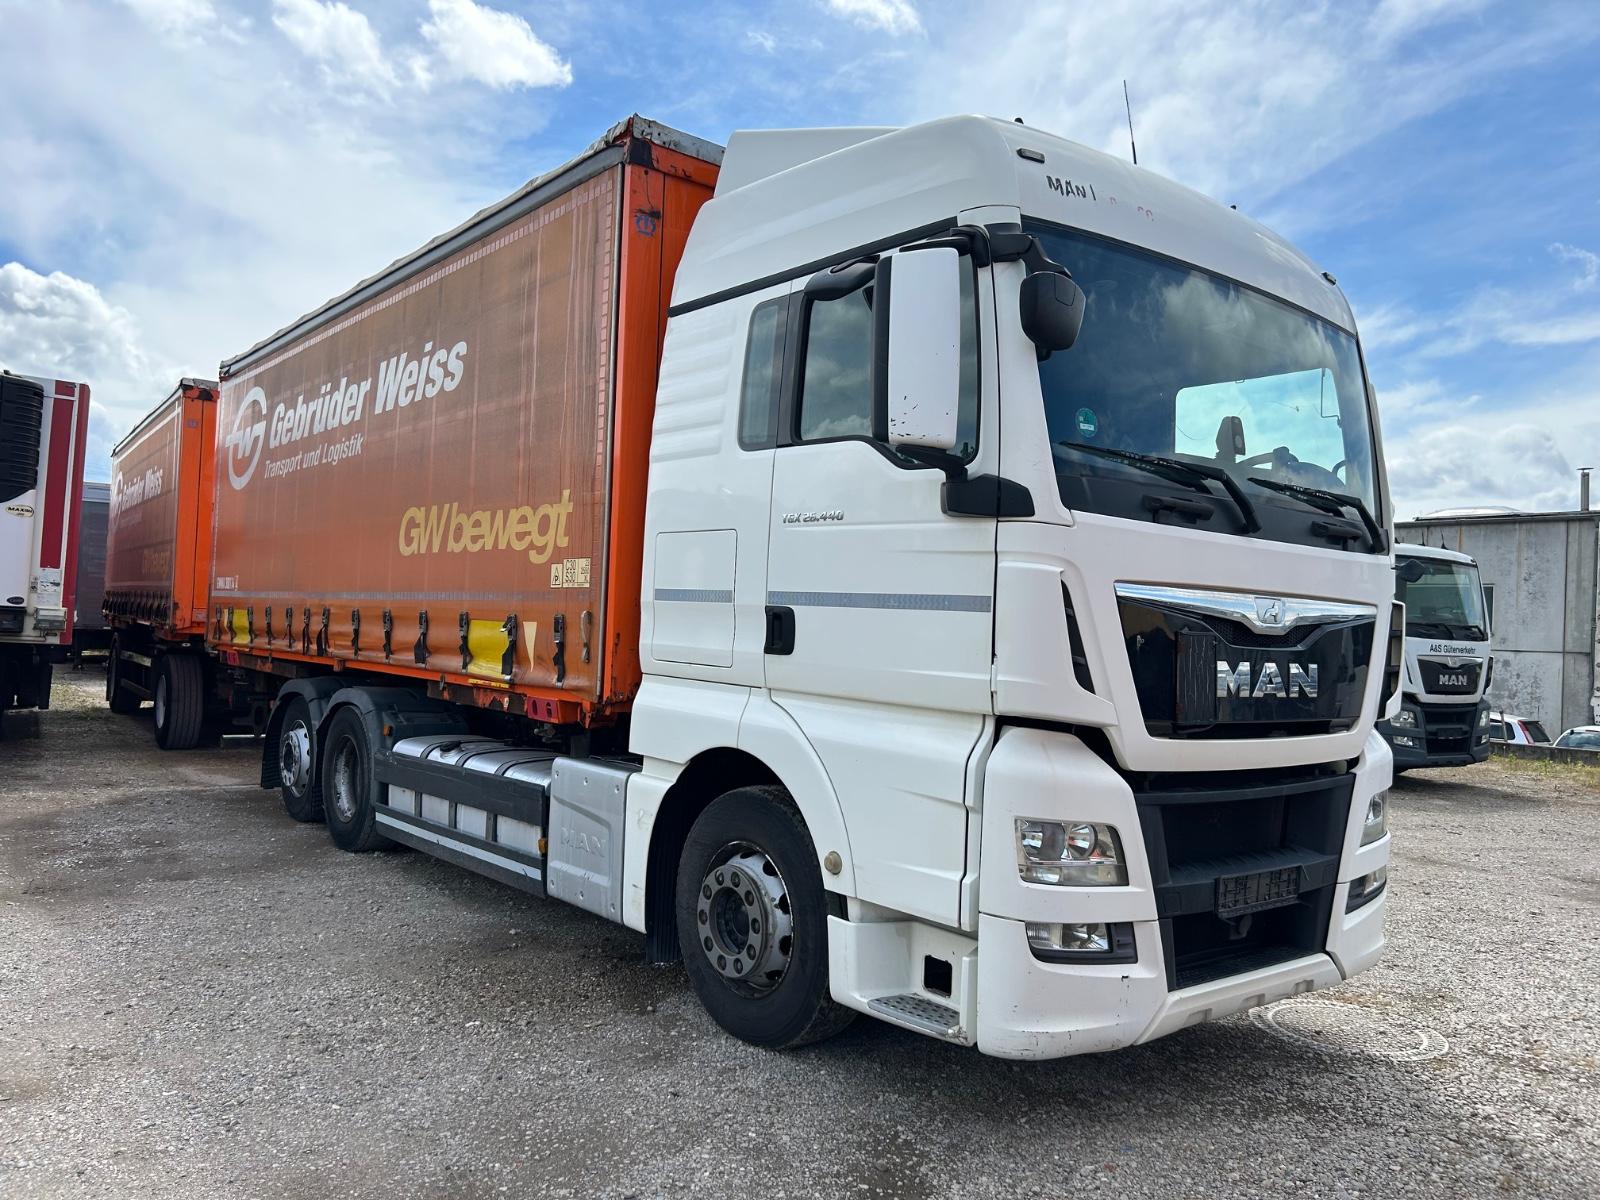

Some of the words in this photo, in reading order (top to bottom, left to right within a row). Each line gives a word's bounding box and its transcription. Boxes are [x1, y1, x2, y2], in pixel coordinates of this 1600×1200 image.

[270, 377, 372, 449] Gebrüder
[374, 341, 467, 415] Weiss
[264, 453, 302, 479] Transport
[303, 445, 321, 468] und
[322, 433, 364, 465] Logistik
[783, 512, 802, 524] TGX
[1429, 644, 1442, 653] A&S
[1216, 660, 1318, 698] MAN
[1439, 674, 1468, 686] MAN
